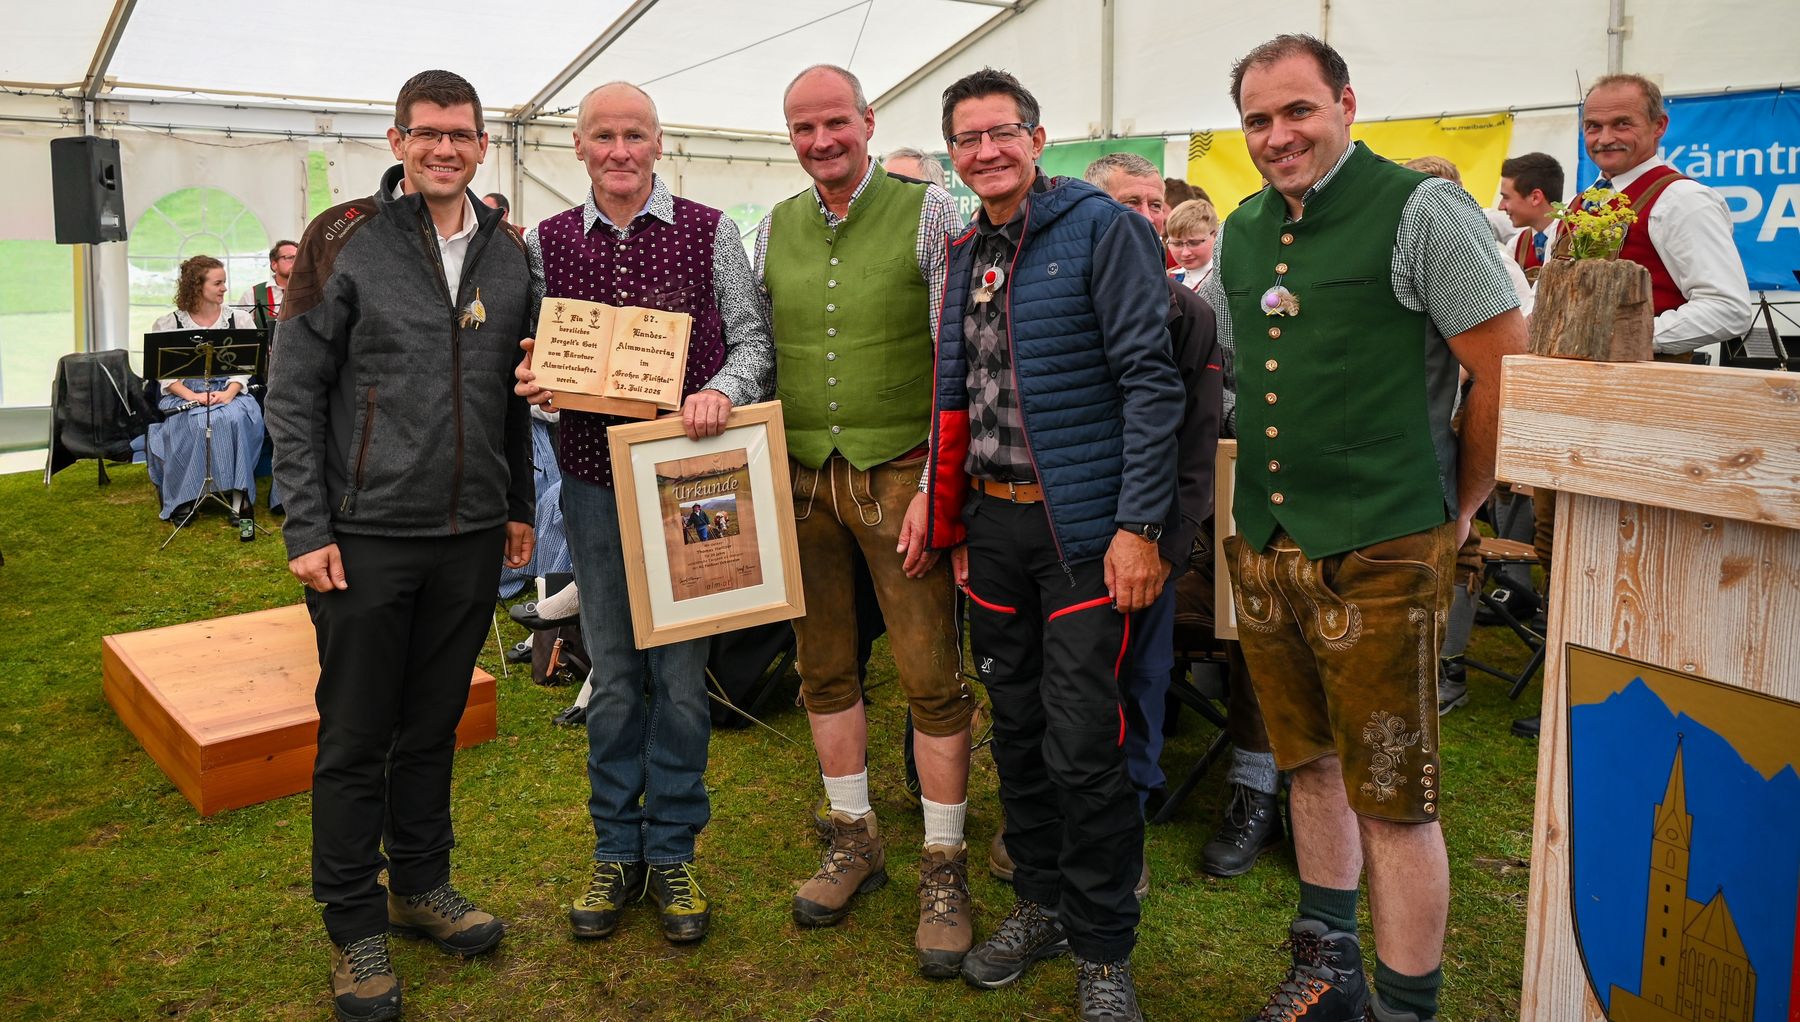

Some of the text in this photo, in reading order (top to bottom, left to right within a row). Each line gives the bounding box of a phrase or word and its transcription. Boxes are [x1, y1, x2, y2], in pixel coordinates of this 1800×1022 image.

[325, 207, 362, 241] alm-at
[570, 314, 584, 323] Ein
[643, 314, 658, 324] 87.
[632, 328, 667, 340] Landes-
[582, 341, 598, 349] Gott
[615, 341, 675, 359] Almwandertag
[563, 350, 595, 361] Kärntner
[541, 361, 597, 375] Almwirtschafts-
[639, 359, 649, 367] im
[628, 384, 643, 393] Juli
[644, 387, 661, 395] 2025
[672, 474, 740, 500] Urkunde
